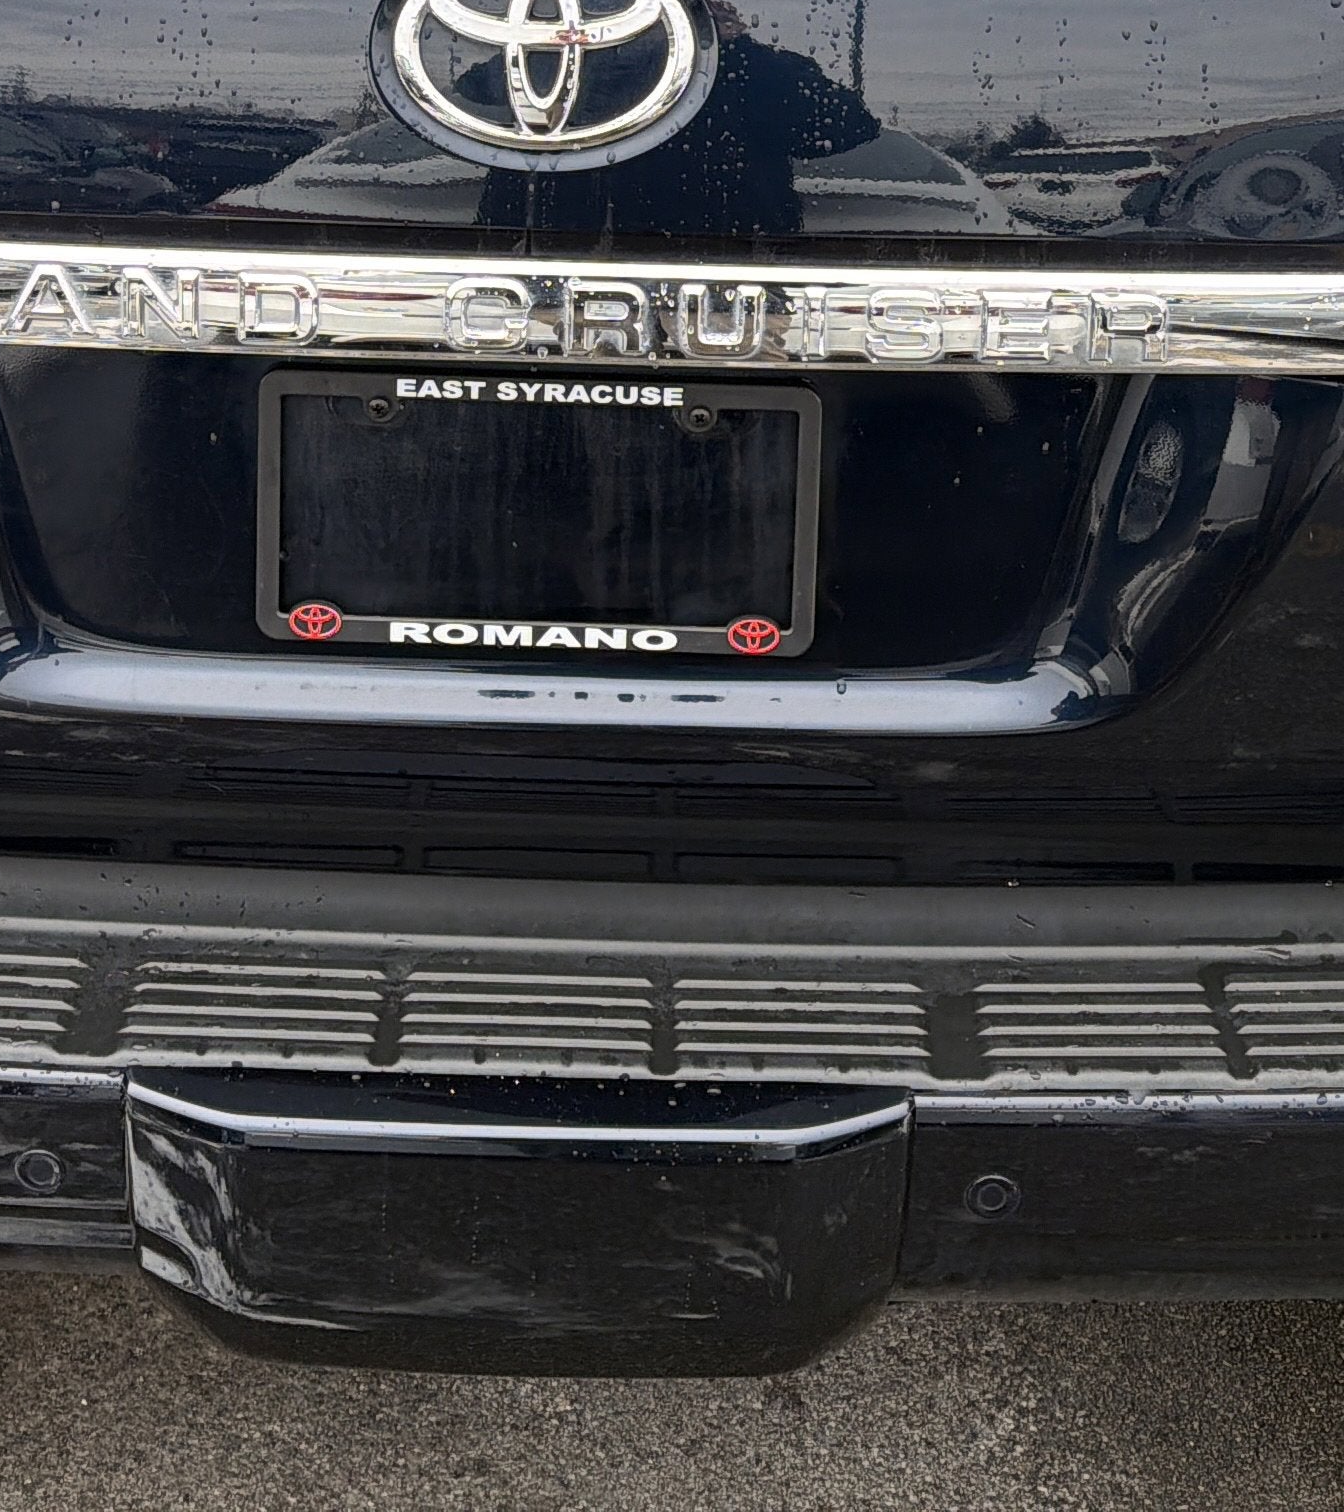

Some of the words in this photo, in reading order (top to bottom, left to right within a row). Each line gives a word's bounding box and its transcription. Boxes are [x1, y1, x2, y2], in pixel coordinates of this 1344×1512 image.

[442, 274, 1170, 365] CRUISER
[395, 378, 486, 399] EAST
[496, 381, 685, 407] SYRACUSE
[389, 621, 678, 651] ROMANO
